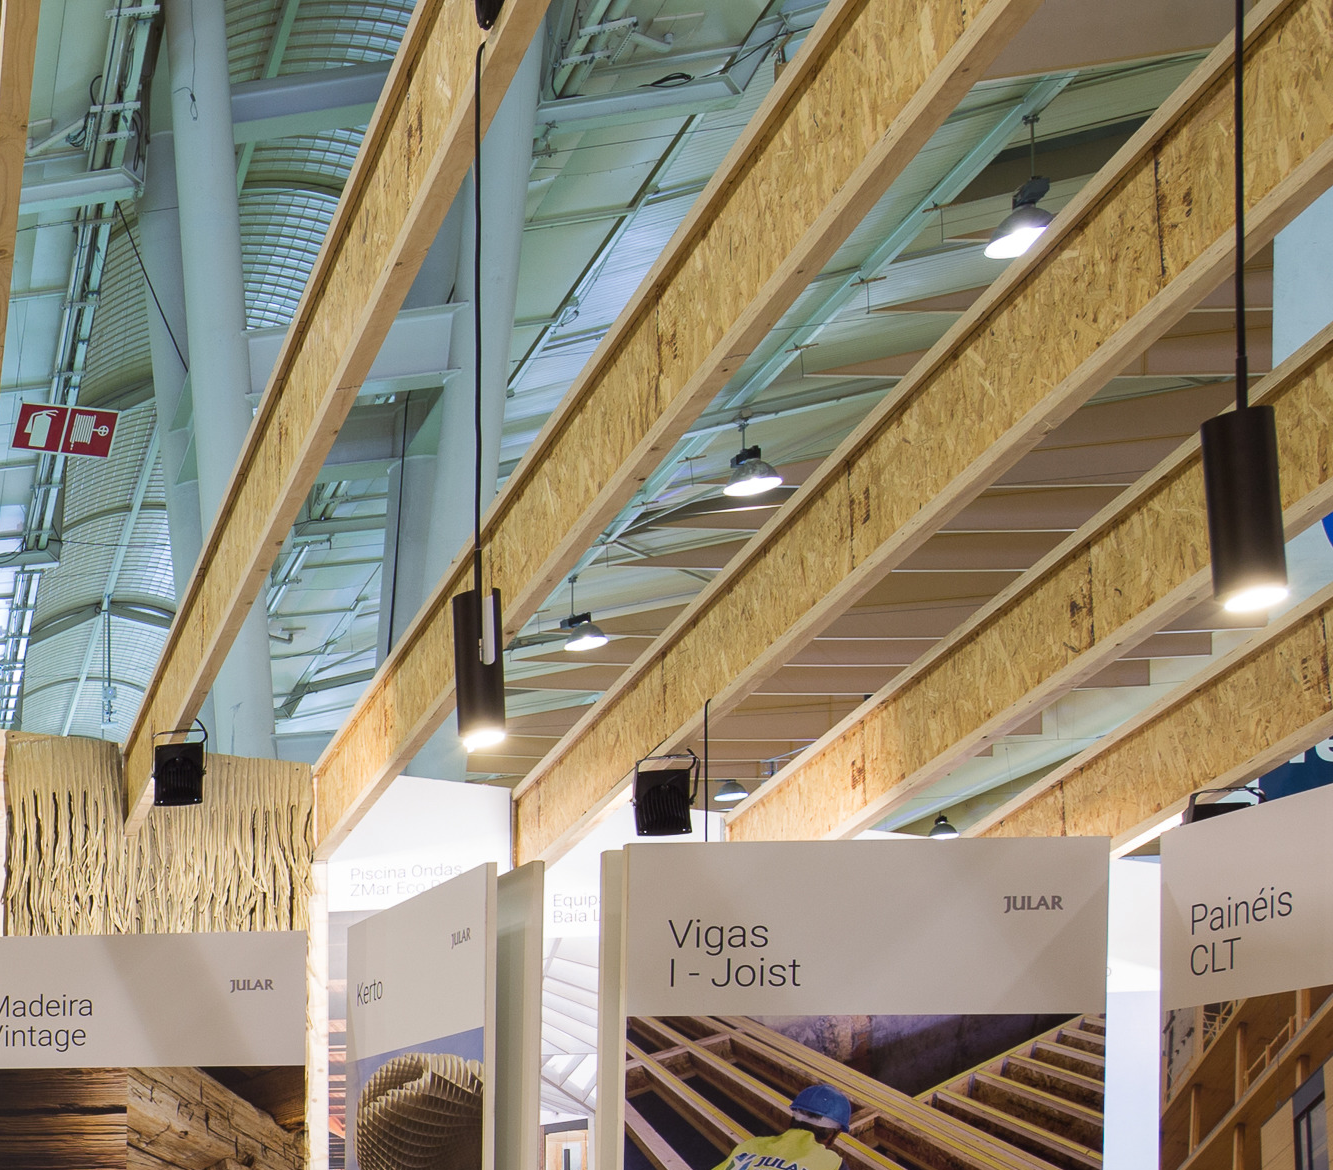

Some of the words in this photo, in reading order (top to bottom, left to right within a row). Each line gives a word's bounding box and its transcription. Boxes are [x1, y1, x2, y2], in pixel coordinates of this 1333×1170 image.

[350, 865, 406, 880] Piscina
[350, 882, 392, 897] ZMar
[553, 893, 600, 909] Equip
[1003, 895, 1064, 914] JULAR
[1191, 886, 1293, 936] Painéis
[451, 927, 471, 949] JULAR
[668, 918, 769, 956] Vigas
[1190, 936, 1241, 976] CLT
[711, 957, 801, 988] Joist
[229, 978, 274, 993] JULAR
[356, 978, 384, 1007] Kerto
